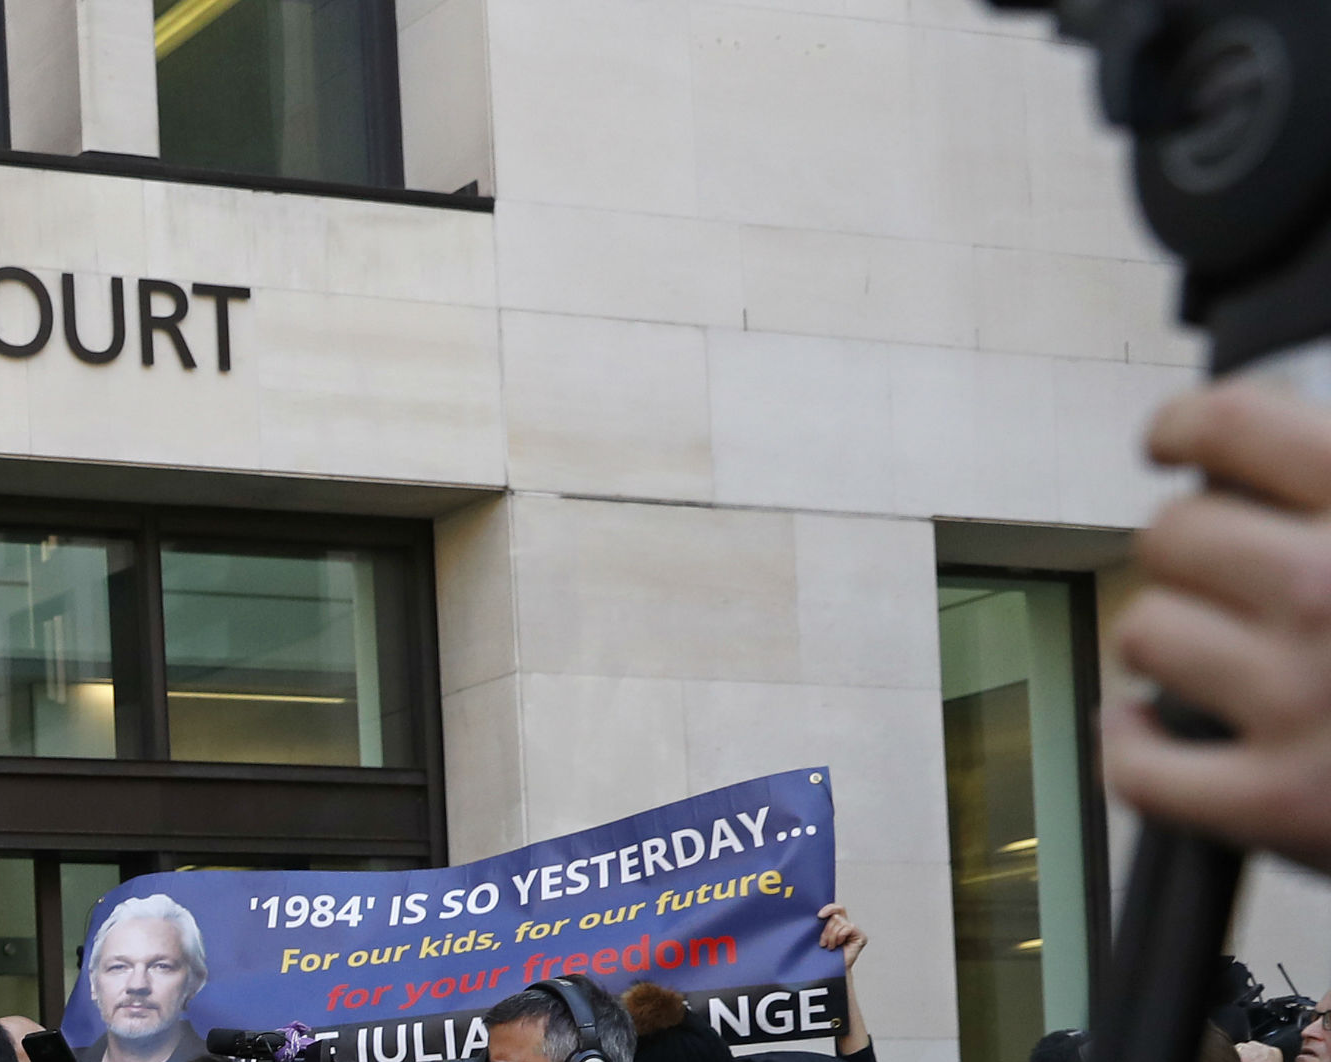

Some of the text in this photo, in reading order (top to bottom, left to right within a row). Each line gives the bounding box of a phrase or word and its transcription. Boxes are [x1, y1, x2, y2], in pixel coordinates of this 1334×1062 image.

[249, 806, 819, 929] '1984' IS SO YESTERDAY...
[281, 868, 796, 974] For our kids, for our future,
[327, 932, 738, 1012] for your freedom
